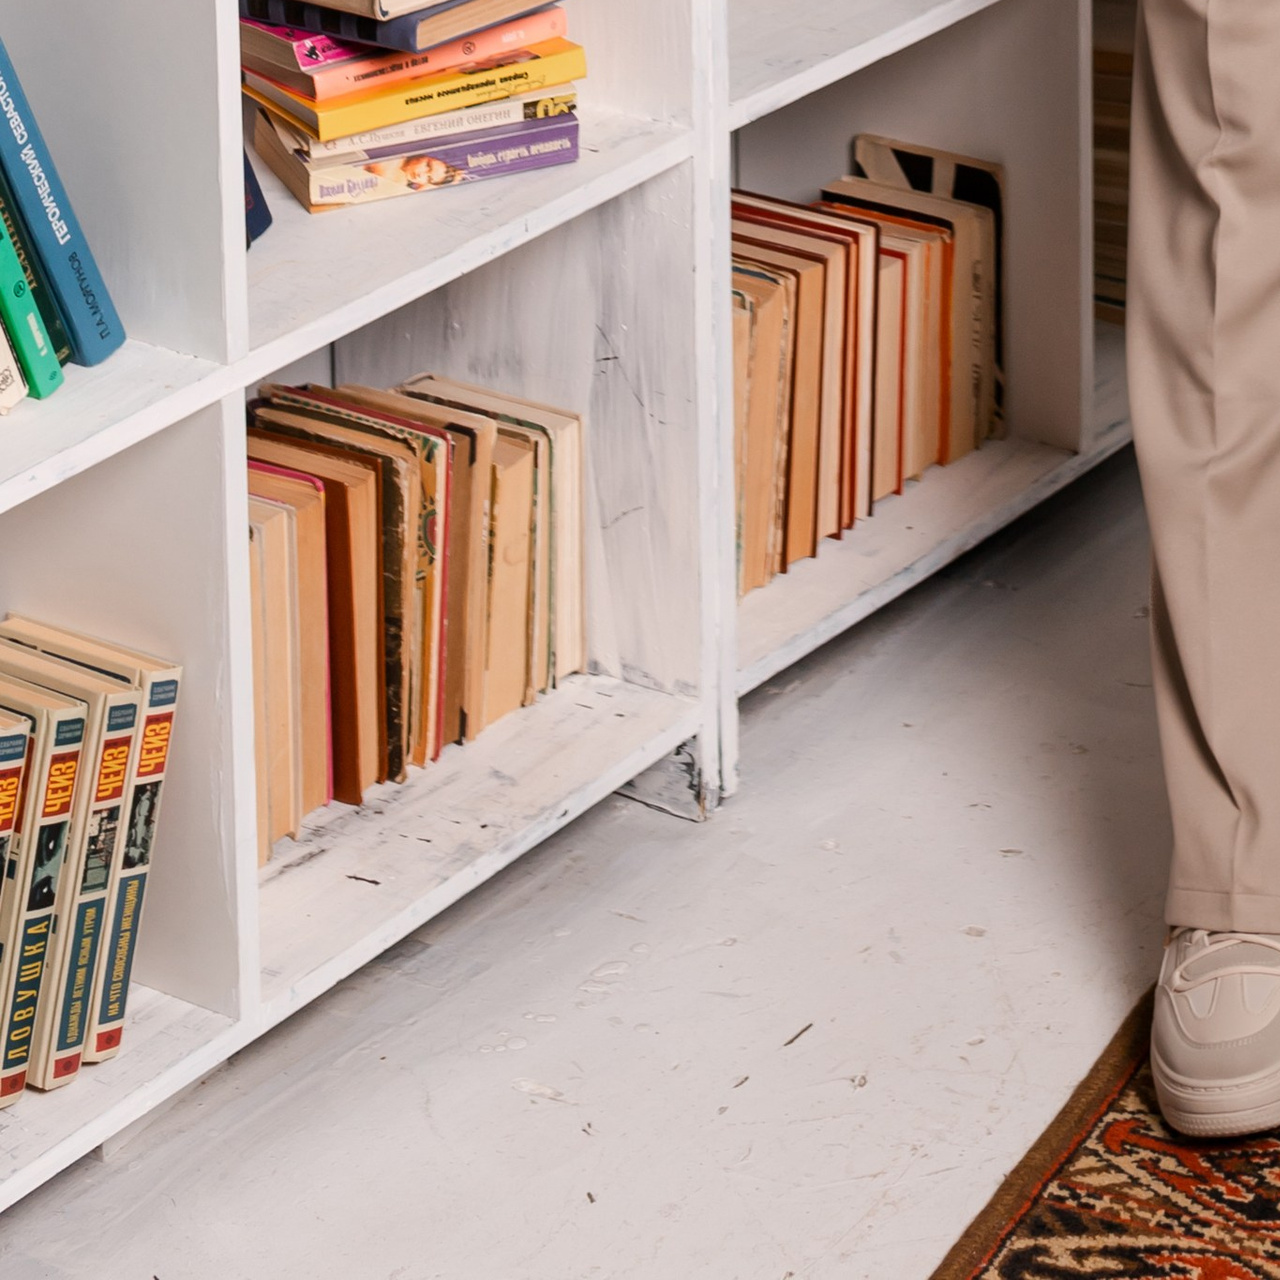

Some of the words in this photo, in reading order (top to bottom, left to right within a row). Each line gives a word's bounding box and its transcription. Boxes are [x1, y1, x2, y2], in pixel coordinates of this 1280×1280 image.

[405, 89, 434, 106] месяца
[437, 75, 496, 99] тринадцатого
[499, 69, 530, 86] Страна
[412, 116, 463, 135] ЕВГЕНИЙ
[466, 106, 512, 125] ОНЕГИН
[19, 143, 71, 246] ГЕРОИЧЕСКИЙ
[67, 250, 111, 340] П.А.МОРГУНОВ
[139, 720, 171, 774] ЧЕЙЗ
[43, 758, 77, 815] ЧЕЙЗ
[97, 745, 129, 798] ЧЕЙЗ
[83, 906, 97, 933] УТРОМ
[118, 879, 139, 931] ЖЕНЩИНЫ
[79, 932, 93, 961] ЯСНЫМ
[110, 931, 130, 981] СПОСОБНЫ
[7, 919, 49, 1060] ЛОВУШКА
[74, 961, 87, 998] ЛЕТНИМ
[109, 981, 122, 1000] ЧТО
[65, 998, 83, 1044] ОДНАЖДЫ
[107, 1000, 120, 1017] НА
